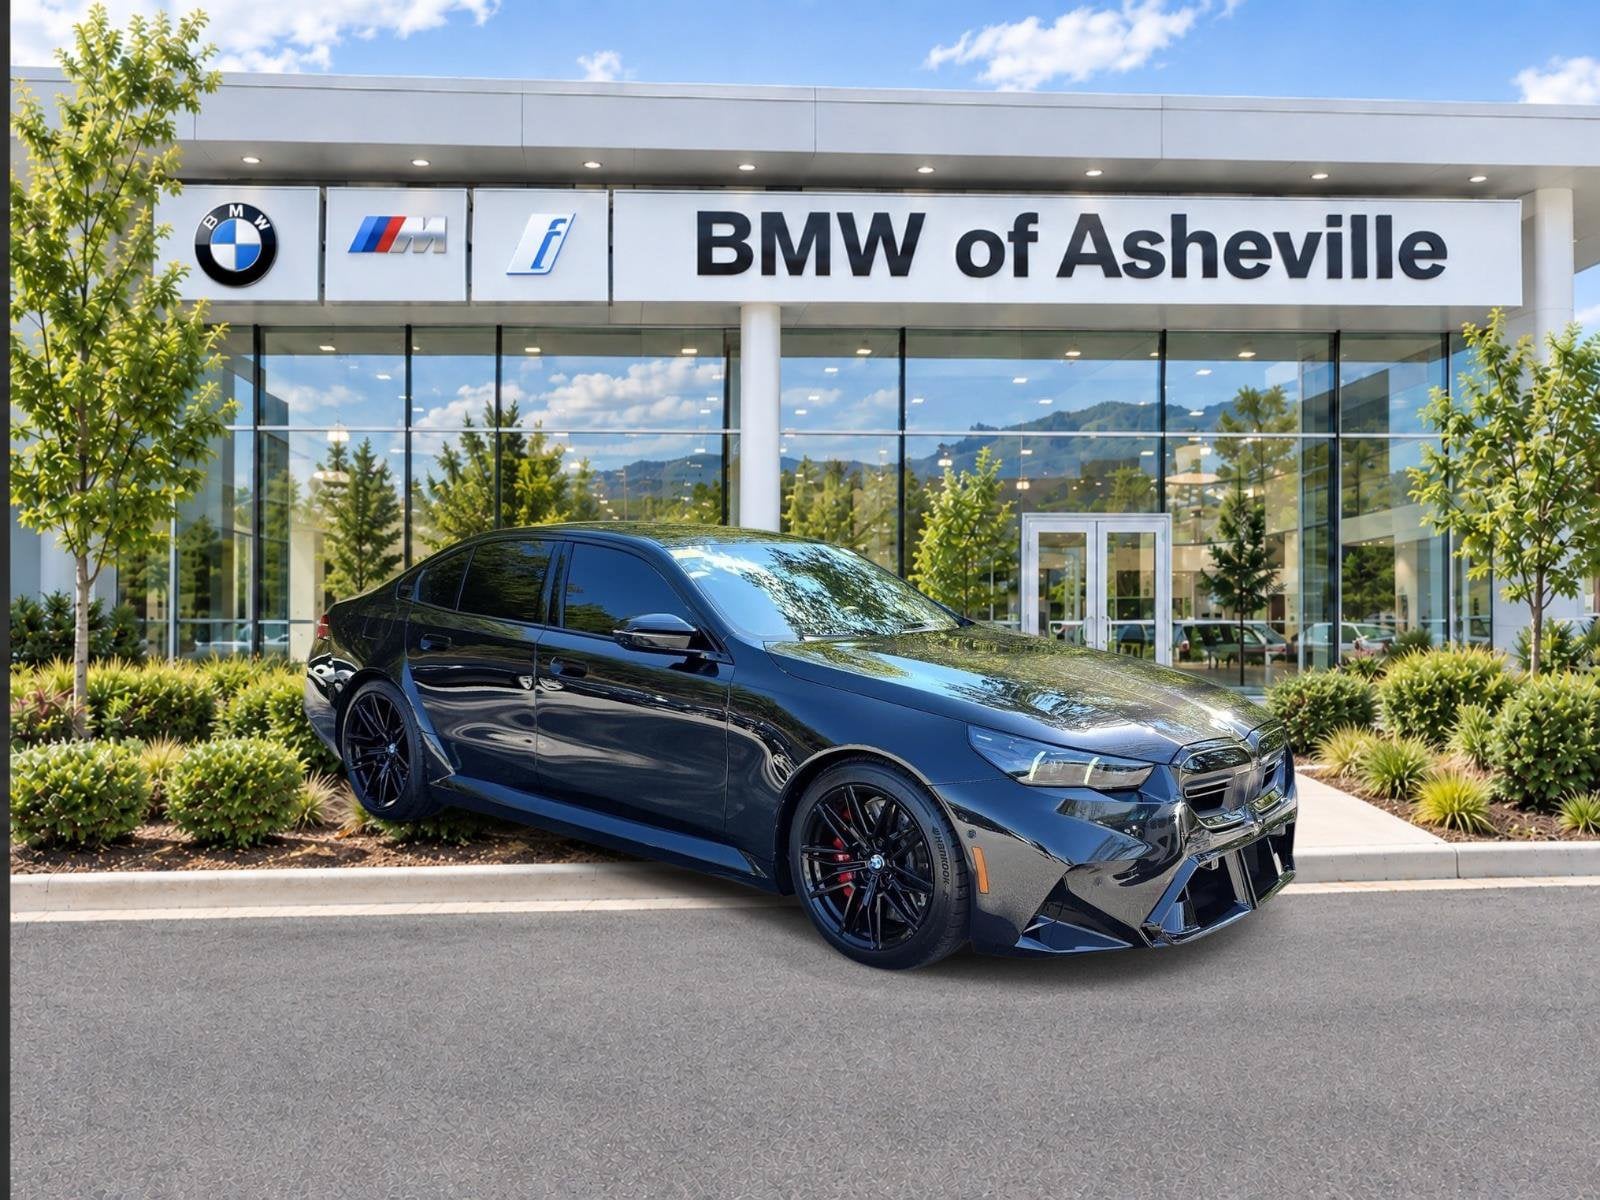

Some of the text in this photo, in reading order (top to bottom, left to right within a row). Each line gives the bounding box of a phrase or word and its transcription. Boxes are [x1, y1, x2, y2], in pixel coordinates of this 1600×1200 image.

[202, 204, 271, 231] BMW
[390, 215, 448, 254] M
[697, 211, 1448, 281] BMW of Asheville
